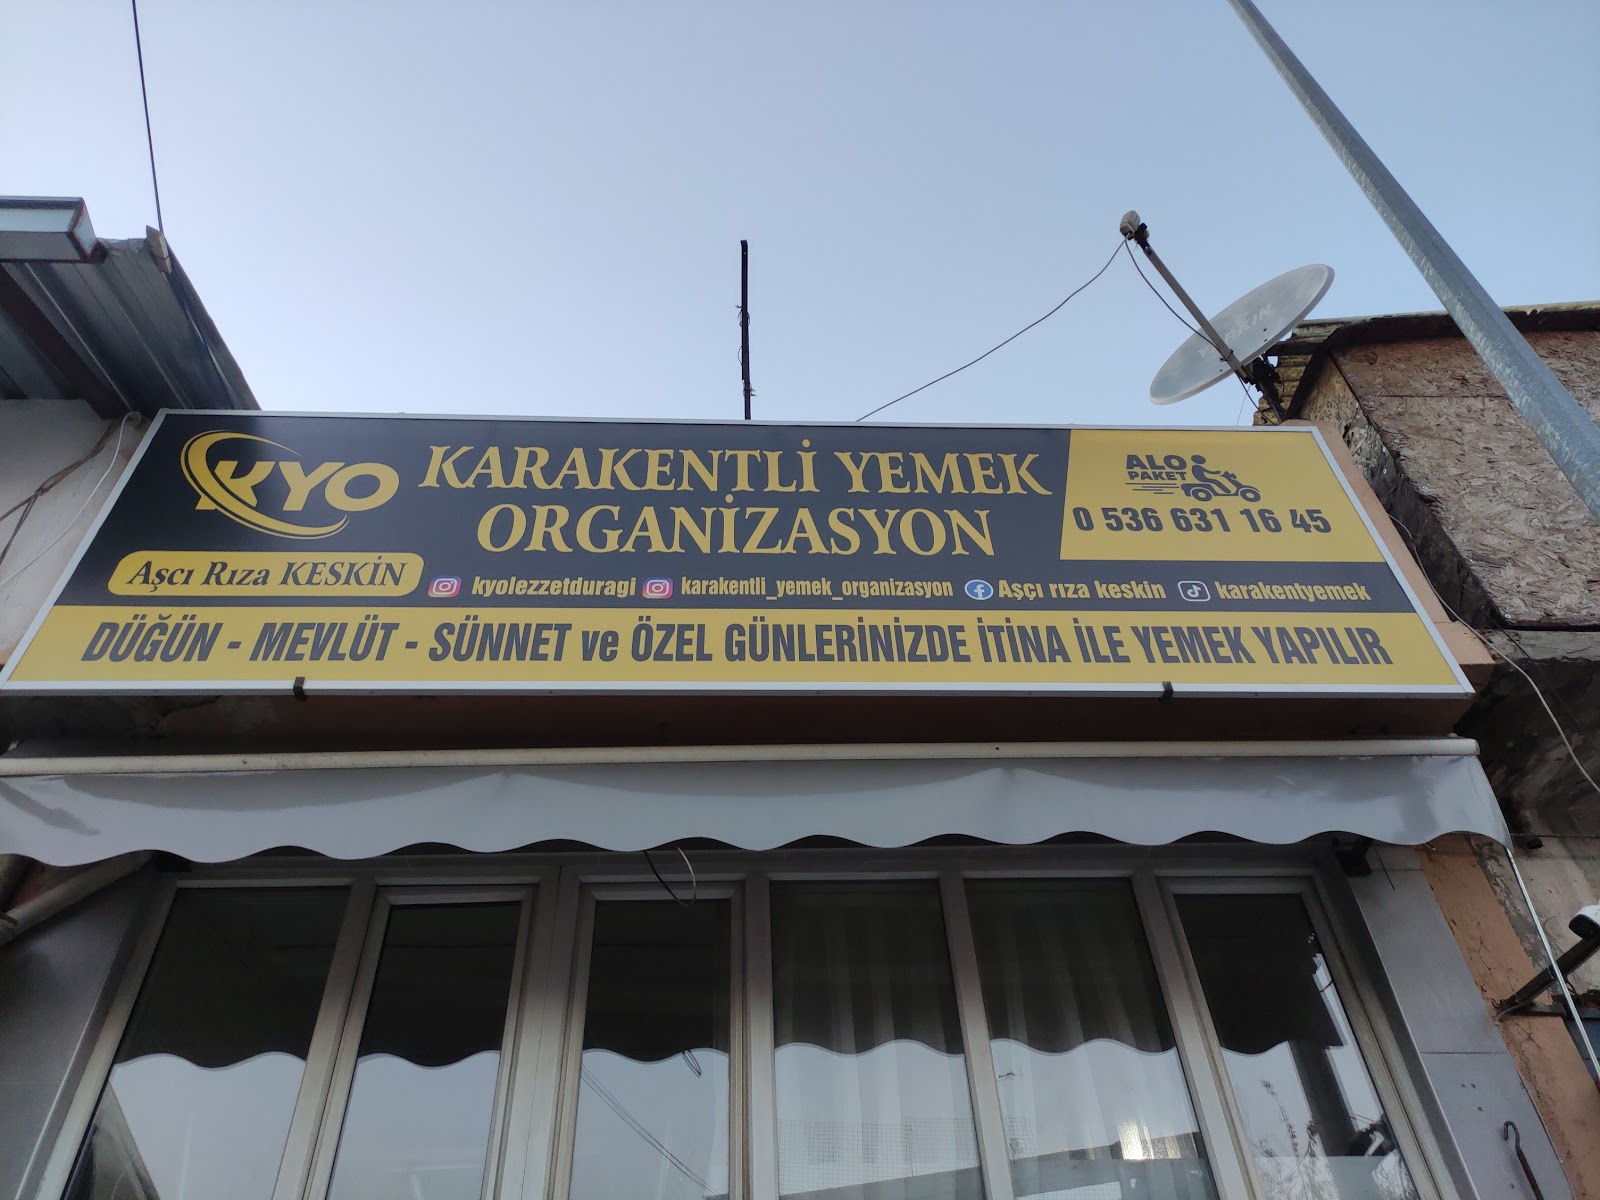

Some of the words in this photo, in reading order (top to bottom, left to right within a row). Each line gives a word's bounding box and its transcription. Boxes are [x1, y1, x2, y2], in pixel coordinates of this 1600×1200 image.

[417, 438, 820, 492] KARAKENTLİ
[833, 450, 1053, 495] YEMEK
[1125, 453, 1188, 471] ALO
[194, 460, 399, 512] KYO
[1127, 470, 1187, 482] PAKET
[476, 493, 995, 555] ORGANİZASYON
[1071, 506, 1095, 532] 0
[1100, 506, 1164, 533] 536
[1169, 507, 1231, 533] 631
[1239, 508, 1283, 534] 16
[1288, 508, 1332, 534] 45
[125, 560, 195, 592] Aşcı
[200, 560, 271, 586] Rıza
[277, 554, 409, 587] KESKİN
[471, 575, 637, 598] kyolezzetduragi
[680, 576, 954, 601] karakentli_yemek_organizasyon
[997, 579, 1044, 601] Aşçı
[1048, 581, 1091, 599] rıza
[1093, 580, 1167, 600] keskin
[1213, 580, 1372, 603] karakentyemek
[80, 612, 224, 663] DÜĞÜN
[248, 613, 401, 662] MEVLÜT
[427, 614, 573, 662] SÜNNET
[580, 630, 620, 662] ve
[631, 615, 713, 662] ÖZEL
[724, 616, 972, 663] GÜNLERİNİZDE
[978, 615, 1072, 663] İTİNA
[1072, 616, 1132, 664] İLE
[1130, 624, 1257, 664] YEMEK
[1249, 626, 1394, 665] YAPILIR
